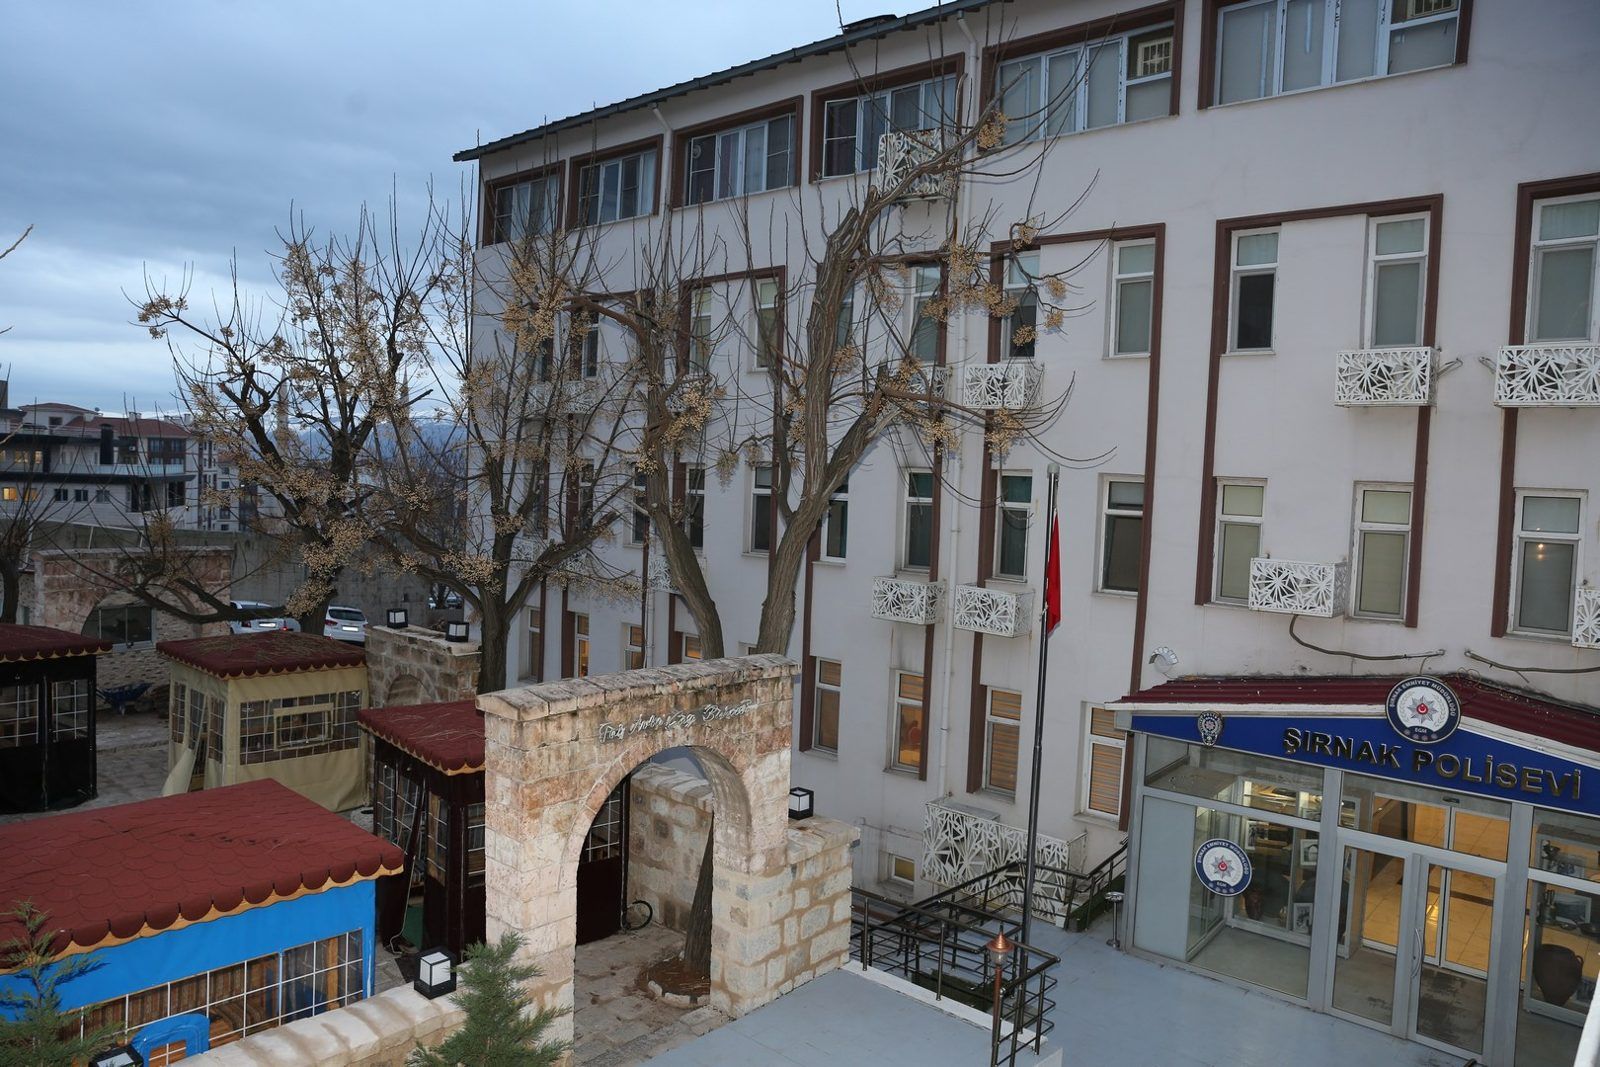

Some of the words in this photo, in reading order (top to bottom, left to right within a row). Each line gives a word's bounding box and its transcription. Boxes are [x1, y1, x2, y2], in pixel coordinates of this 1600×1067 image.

[1402, 680, 1430, 688] EMNİYET
[1431, 683, 1456, 716] MÜDÜRLÜĞÜ
[1282, 726, 1402, 769] ŞIRNAK
[1411, 748, 1582, 801] POLİSEVİ
